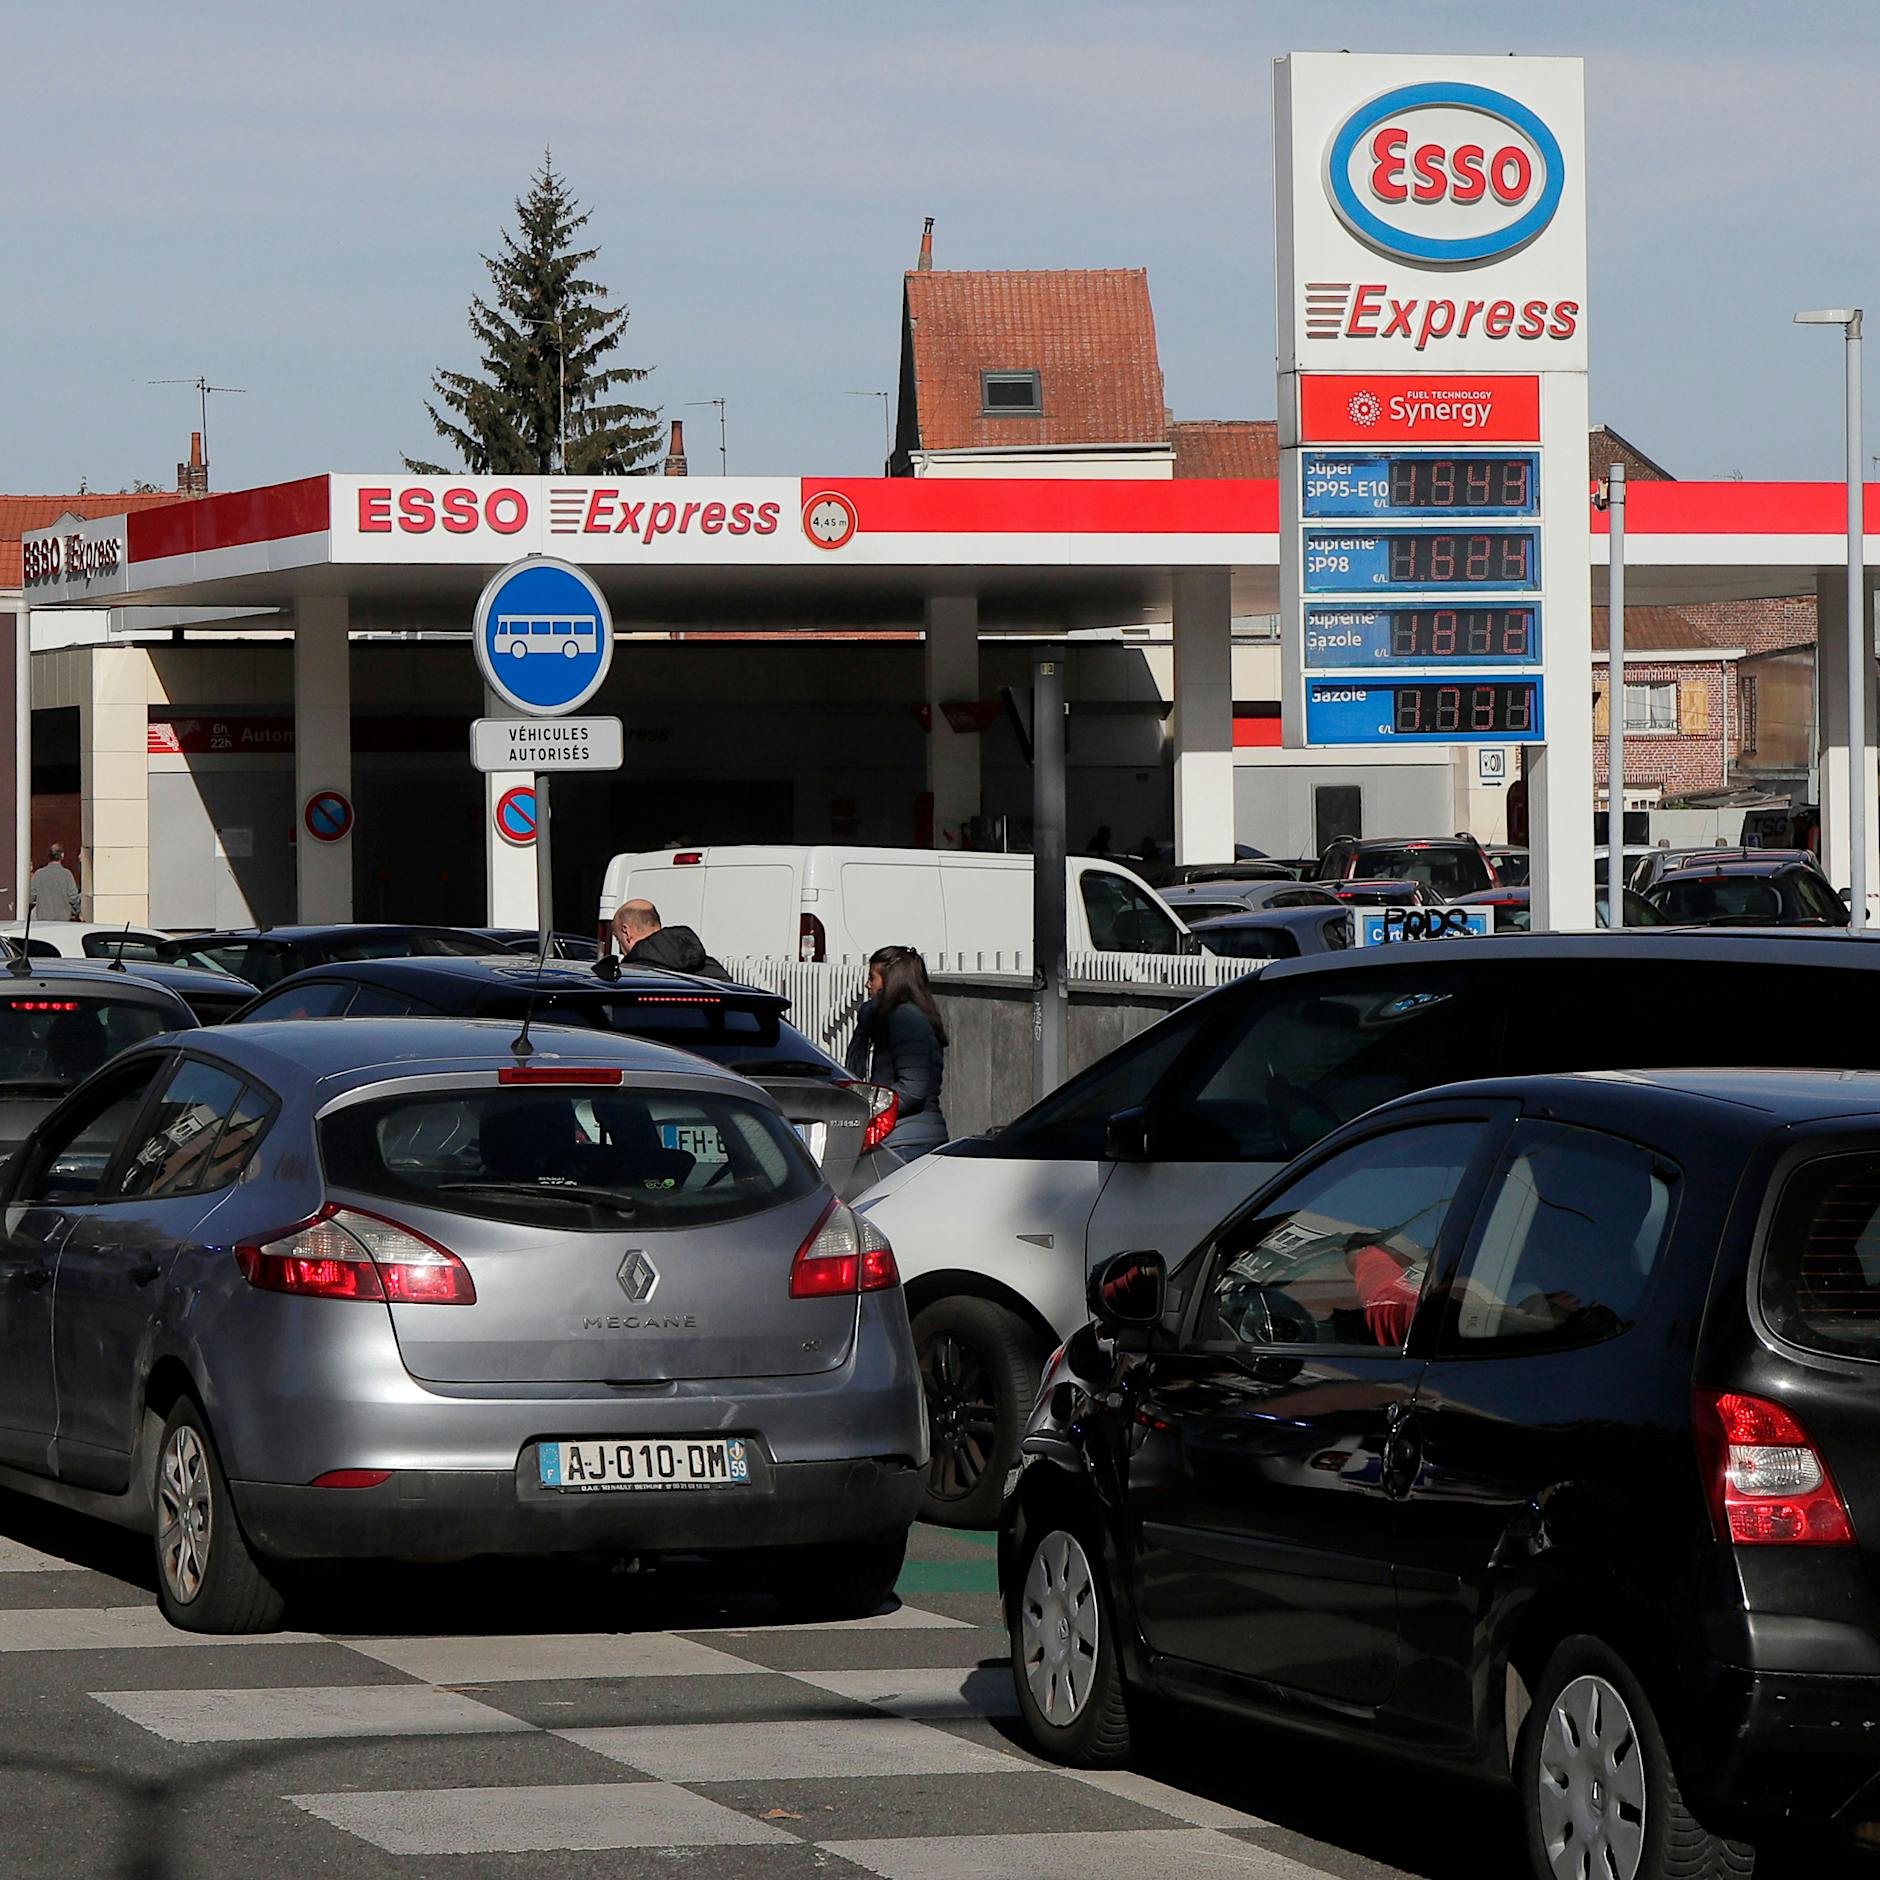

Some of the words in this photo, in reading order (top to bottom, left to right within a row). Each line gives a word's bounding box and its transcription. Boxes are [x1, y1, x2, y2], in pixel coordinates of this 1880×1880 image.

[1344, 283, 1580, 351] Express
[1407, 391, 1431, 399] FUEL
[1432, 391, 1492, 399] TECHNOLOGY
[1389, 396, 1492, 428] Synergy
[1307, 481, 1389, 498] SP95-E10
[358, 487, 529, 535] ESSO
[582, 489, 781, 544] Express
[812, 516, 837, 529] 4,45
[23, 537, 62, 579] ESSO
[70, 533, 121, 578] Express
[1308, 556, 1350, 573] SP98
[1308, 630, 1363, 647] Gazole
[212, 722, 229, 735] 6h
[508, 726, 589, 741] VÉHICULES
[210, 737, 232, 749] 22h
[509, 745, 590, 761] AUTORISÉS
[583, 1315, 697, 1329] MEGANE
[546, 1468, 554, 1480] F
[567, 1444, 728, 1481] AJ-010-DM
[731, 1460, 748, 1477] 59
